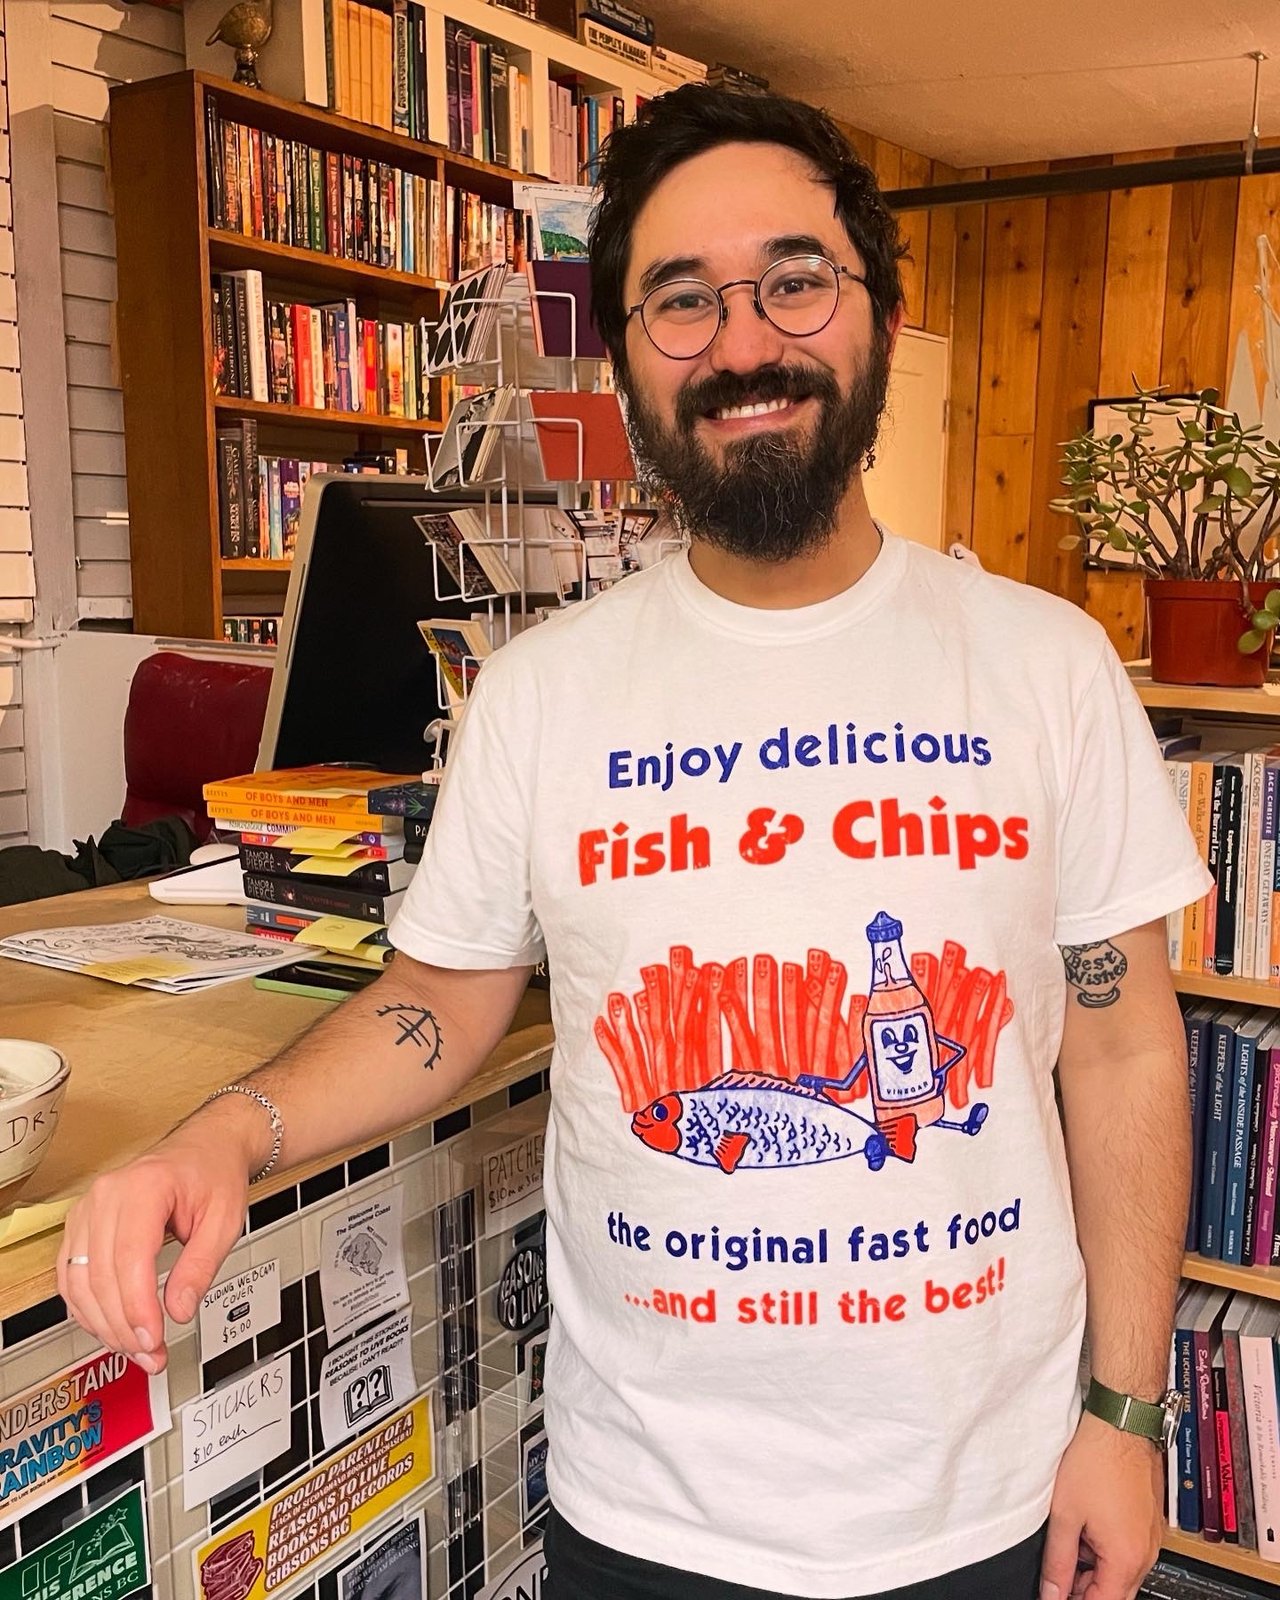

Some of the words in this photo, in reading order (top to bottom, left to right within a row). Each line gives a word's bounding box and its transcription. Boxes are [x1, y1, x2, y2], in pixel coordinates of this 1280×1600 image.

[608, 742, 743, 792] Enjoy
[758, 722, 992, 771] delicious
[1254, 757, 1262, 777] JACK
[1214, 779, 1222, 798] Walk
[1252, 777, 1261, 807] CHRISTIE
[1267, 771, 1275, 793] JACK
[245, 791, 259, 801] OF
[260, 793, 284, 802] BOYS
[286, 796, 306, 805] AND
[308, 798, 329, 807] MEN
[1265, 795, 1274, 834] CHRISTIE
[251, 809, 264, 818] OF
[266, 810, 290, 820] BOYS
[292, 812, 313, 822] AND
[315, 815, 336, 825] MEN
[1212, 813, 1221, 844] Burrard
[244, 849, 275, 861] TAMORA
[578, 813, 711, 887] Fish
[738, 807, 805, 865] &
[832, 795, 1029, 870] Chips
[1209, 846, 1219, 865] Loop
[1226, 829, 1235, 864] Exploring
[246, 858, 276, 872] PIERCE
[247, 877, 275, 889] TAMORA
[248, 886, 276, 902] PIERCE
[1260, 880, 1270, 923] GETAWAYS
[1068, 950, 1117, 971] Best
[1189, 1029, 1199, 1067] KEEPERS
[1216, 1034, 1226, 1072] KEEPERS
[1240, 1043, 1250, 1076] LIGHTS
[886, 1080, 930, 1096] VINEGAR
[1215, 1073, 1224, 1082] of
[1215, 1081, 1223, 1093] the
[1238, 1076, 1247, 1086] of
[1238, 1086, 1247, 1098] the
[1213, 1093, 1223, 1122] LIGHT
[1236, 1099, 1246, 1128] INSIDE
[1234, 1129, 1244, 1169] PASSAGE
[1268, 1120, 1279, 1166] Vancouver
[488, 1133, 546, 1188] PATCHE
[1265, 1166, 1275, 1197] Island
[488, 1187, 507, 1209] $10
[336, 1227, 347, 1236] The
[348, 1214, 374, 1231] Sunshine
[375, 1206, 391, 1218] Coast
[347, 1207, 374, 1222] Welcome
[607, 1210, 651, 1252] the
[665, 1225, 827, 1271] original
[848, 1220, 930, 1263] fast
[947, 1198, 1021, 1250] food
[203, 1281, 235, 1309] SLIDING
[237, 1261, 276, 1289] WEBCAM
[221, 1284, 254, 1309] COVER
[624, 1289, 717, 1324] ...and
[737, 1290, 818, 1325] still
[838, 1289, 907, 1324] the
[924, 1256, 1006, 1314] best!
[503, 1294, 517, 1328] TO
[521, 1277, 543, 1324] LIVE
[221, 1318, 252, 1344] $5.00
[331, 1344, 359, 1366] BOUGHT
[360, 1336, 374, 1348] THIS
[374, 1321, 400, 1340] STICKER
[399, 1315, 408, 1325] AT
[324, 1353, 359, 1380] REASONS
[359, 1346, 370, 1357] TO
[370, 1337, 385, 1351] LIVE
[385, 1323, 409, 1343] BOOKS
[1182, 1341, 1190, 1358] THE
[1195, 1349, 1208, 1373] Early
[329, 1363, 359, 1387] BECAUSE
[362, 1349, 381, 1367] CAN'T
[1182, 1357, 1191, 1389] UCHUCK
[0, 1351, 128, 1442] NDERSTAND
[193, 1368, 285, 1438] STICKERS
[1183, 1390, 1191, 1413] YEARS
[1199, 1373, 1210, 1420] Recollections
[1253, 1384, 1265, 1423] Victoria
[0, 1399, 104, 1472] RAVITY'S
[192, 1443, 213, 1465] $10
[218, 1423, 248, 1448] each
[0, 1421, 104, 1499] AINBOW
[271, 1471, 327, 1521] PROUD
[328, 1436, 383, 1481] PARENT
[383, 1422, 404, 1443] OF
[401, 1412, 414, 1430] A
[266, 1524, 321, 1571] BOOKS
[320, 1502, 350, 1533] AND
[350, 1454, 414, 1513] RECORDS
[268, 1492, 337, 1551] REASONS
[339, 1479, 358, 1500] TO
[358, 1454, 389, 1488] LIVE
[270, 1512, 293, 1532] STACK
[293, 1504, 303, 1516] OF
[302, 1475, 349, 1511] SECONDHAND
[265, 1534, 330, 1591] GIBSONS
[330, 1517, 351, 1545] BC
[388, 1541, 420, 1566] READING
[116, 1570, 139, 1591] BC
